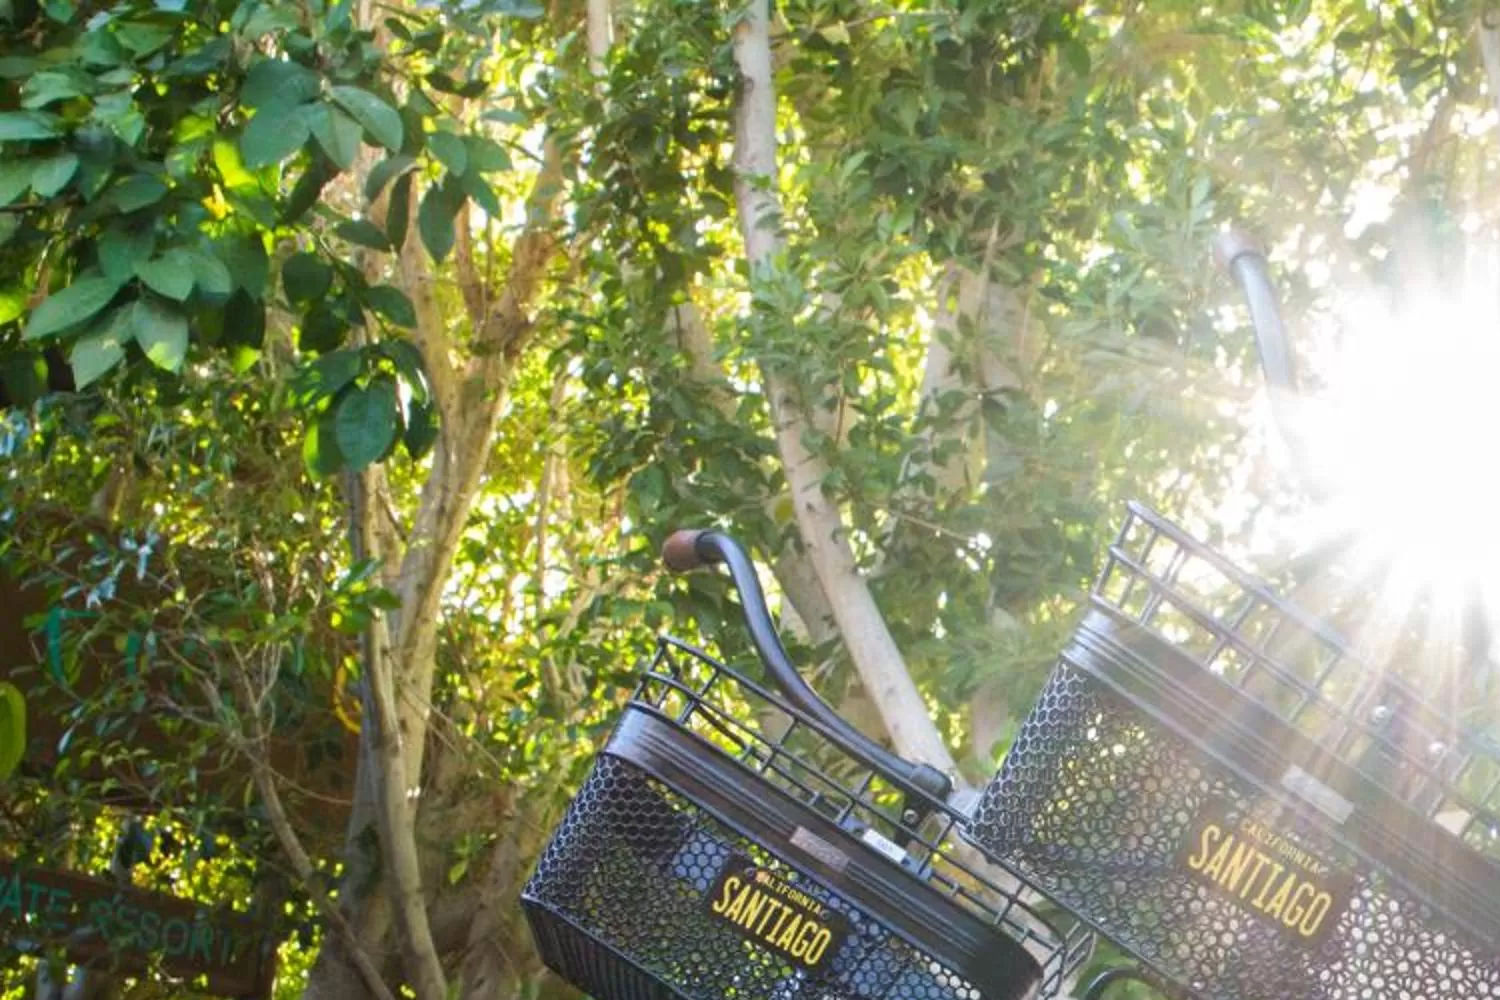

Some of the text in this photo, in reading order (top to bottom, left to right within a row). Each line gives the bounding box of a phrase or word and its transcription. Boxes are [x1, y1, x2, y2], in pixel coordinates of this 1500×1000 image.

[1188, 824, 1333, 937] SANTIAGO
[1241, 818, 1320, 876] CALIFORNIA
[712, 876, 833, 966] SANTIAGO
[757, 873, 821, 914] ALIFORNIA
